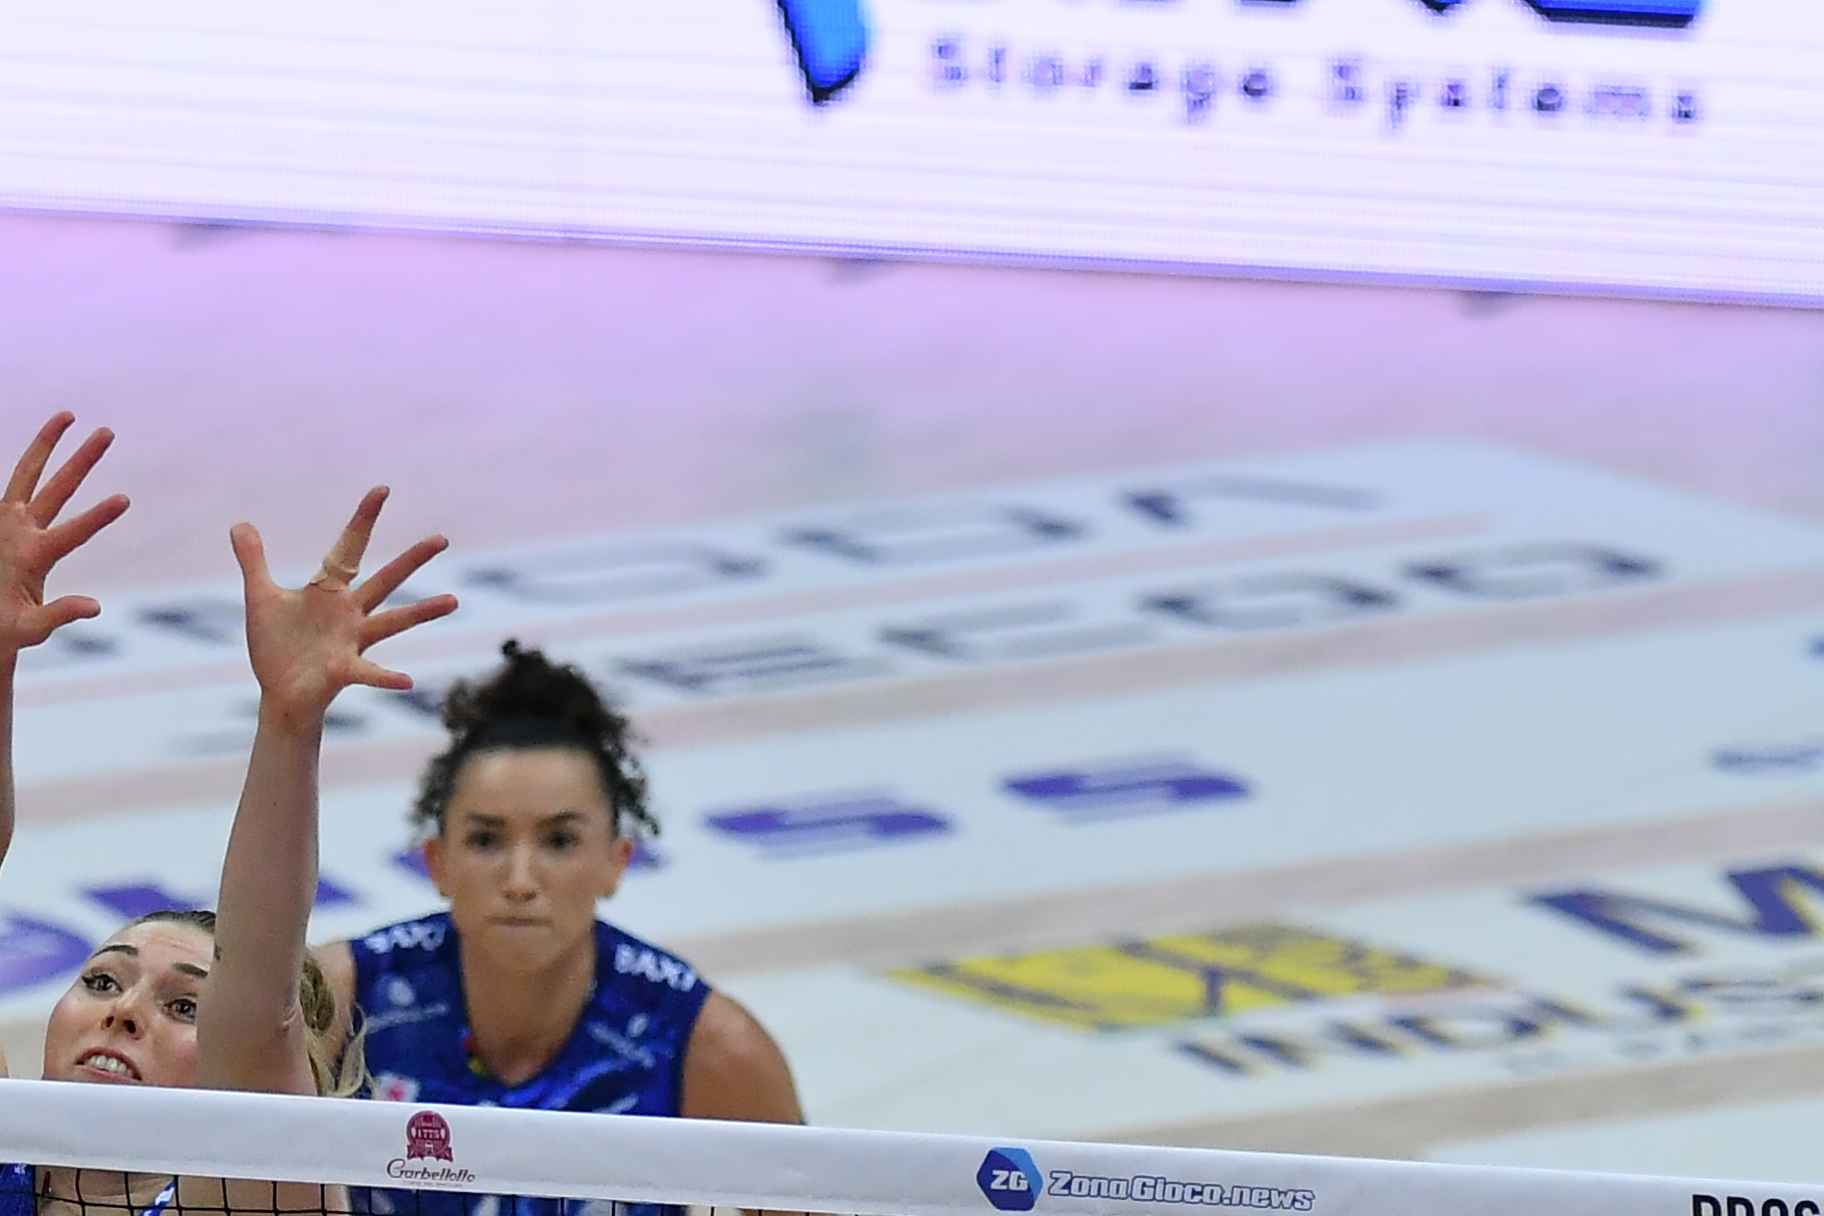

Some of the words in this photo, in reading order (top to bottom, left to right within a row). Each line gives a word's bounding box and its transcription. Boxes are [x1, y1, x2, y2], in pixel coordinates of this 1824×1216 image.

[931, 34, 1273, 126] Storage
[1328, 56, 1700, 134] Systems
[990, 1170, 1028, 1191] ZG
